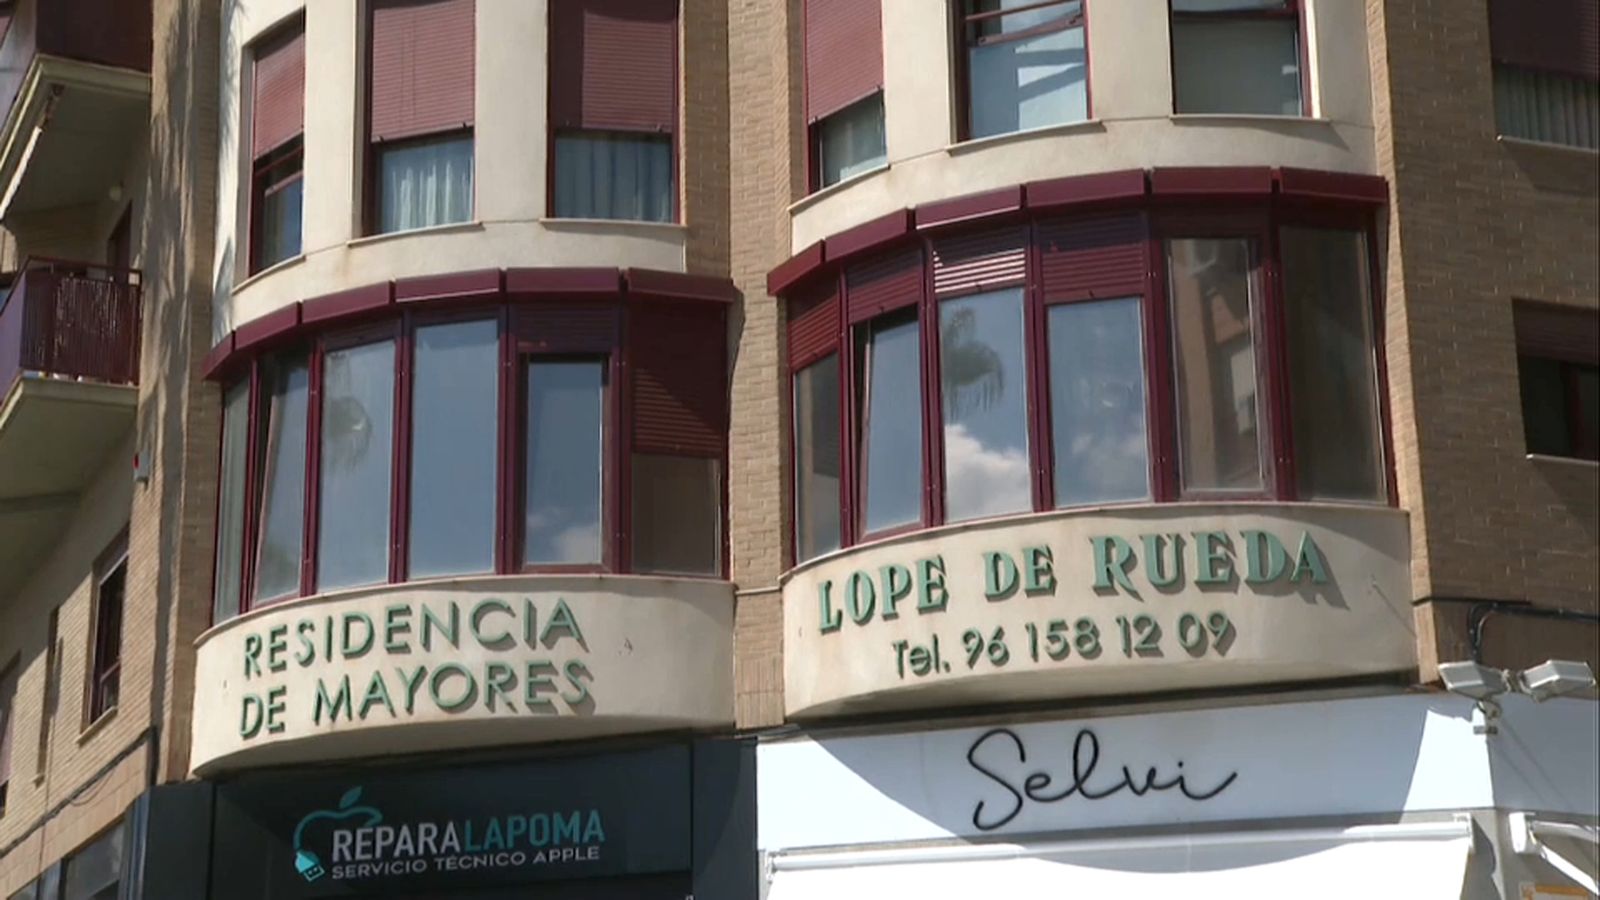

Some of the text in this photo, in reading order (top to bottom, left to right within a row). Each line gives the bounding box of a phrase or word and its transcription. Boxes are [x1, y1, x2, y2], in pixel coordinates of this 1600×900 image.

[818, 530, 1332, 634] LOPE DE RUEDA
[244, 598, 588, 680] RESIDENCIA
[893, 612, 1236, 678] Tel. 96 158 12 09
[240, 659, 594, 738] DE MAYORES
[967, 729, 1237, 831] Selvi
[332, 859, 427, 879] SERVICIO
[533, 846, 599, 864] APPLE
